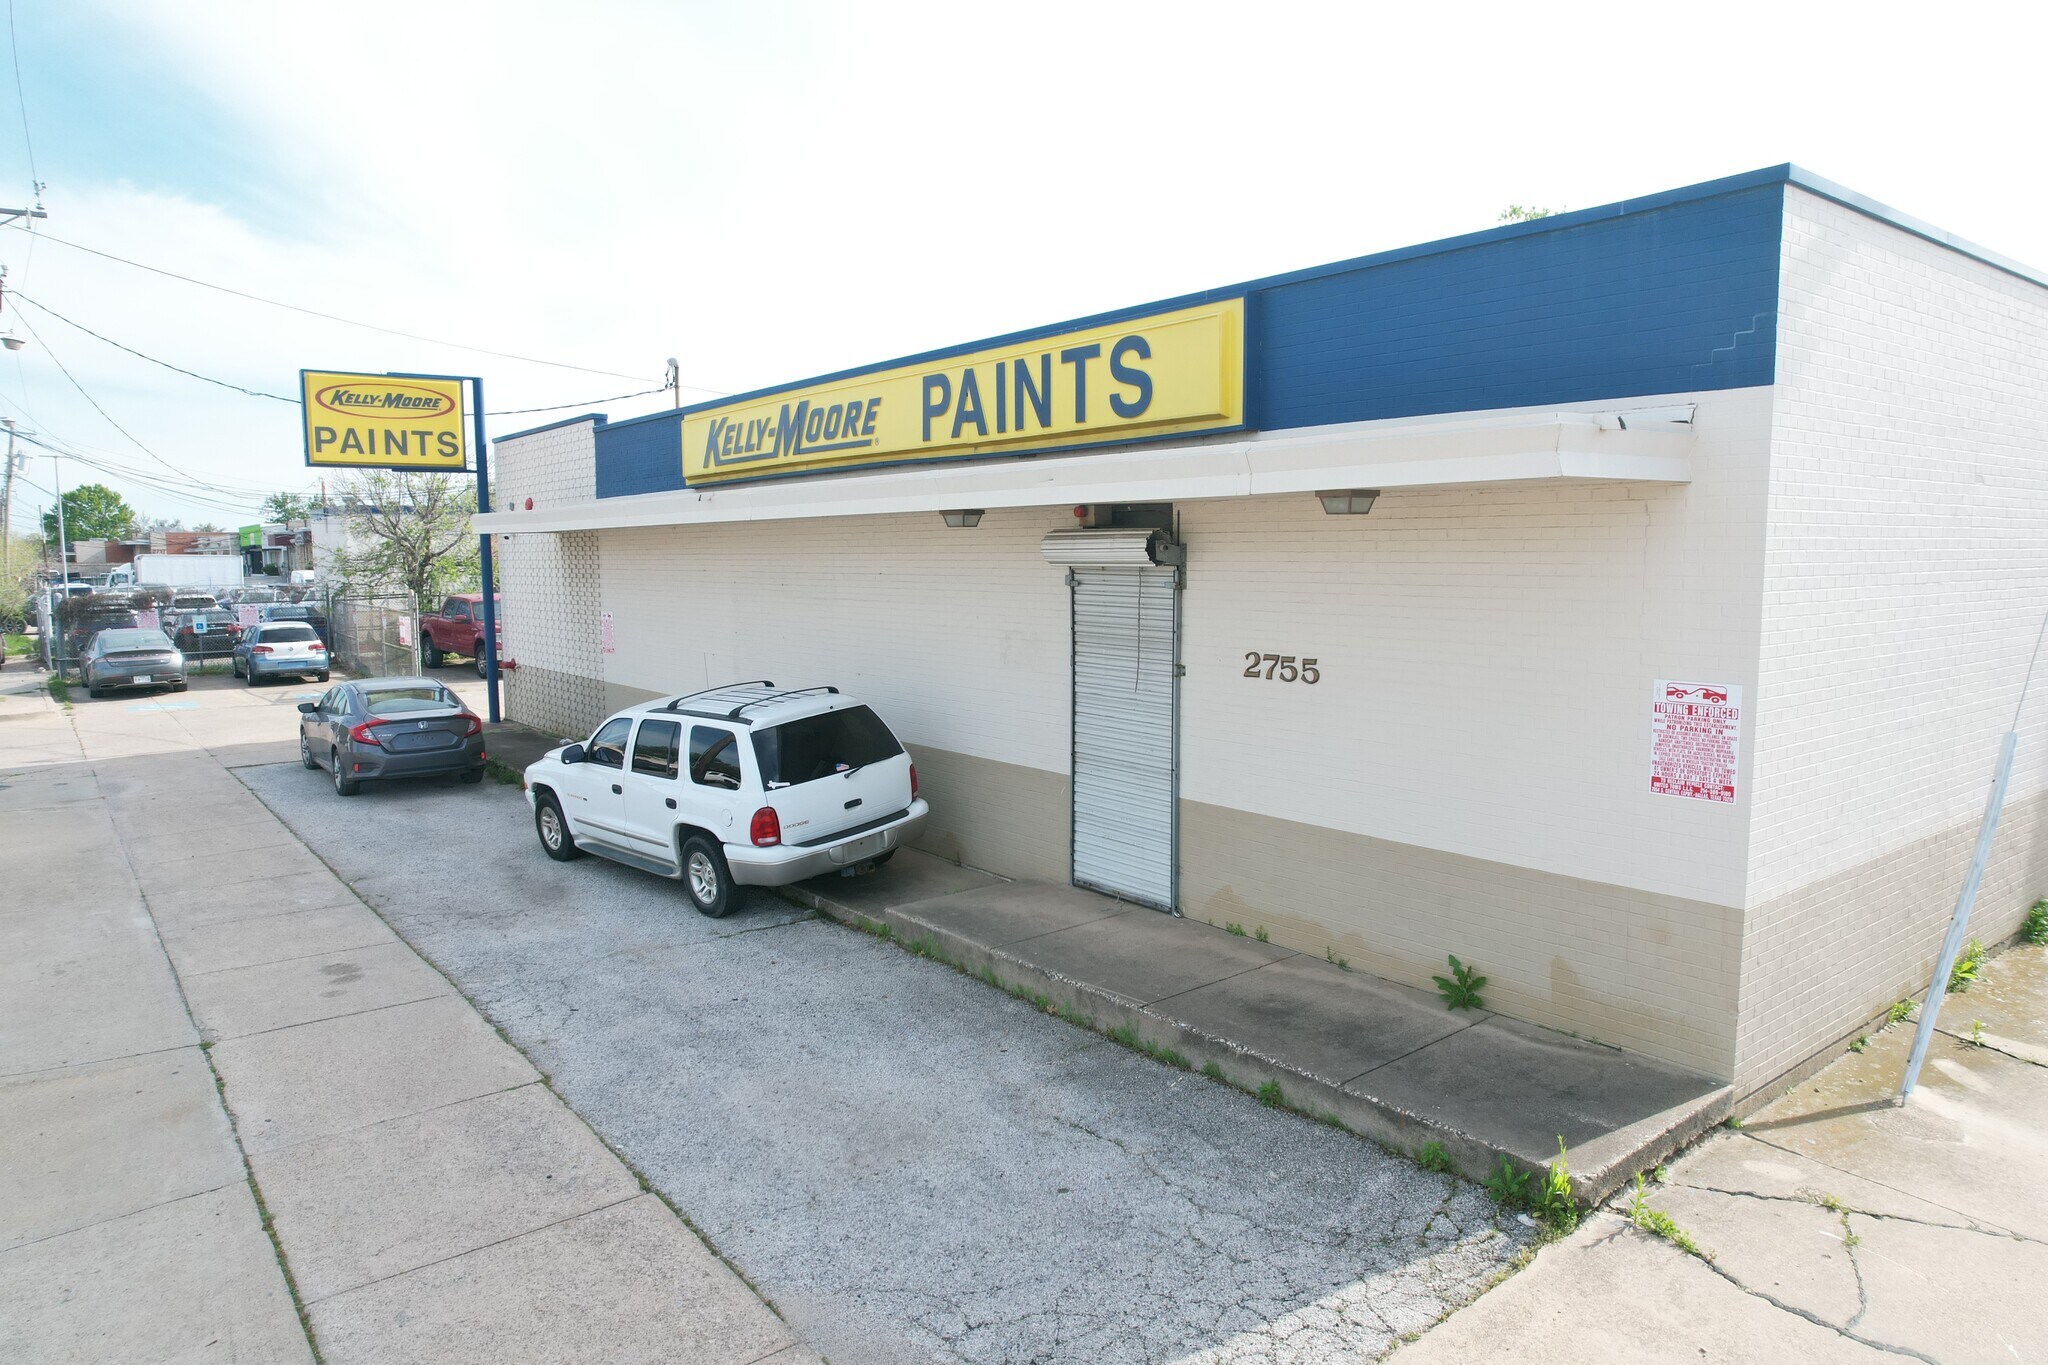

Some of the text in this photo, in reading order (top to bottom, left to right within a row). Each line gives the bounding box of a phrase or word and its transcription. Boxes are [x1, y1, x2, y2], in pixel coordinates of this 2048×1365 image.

[330, 390, 442, 409] KELLY-MOORE
[922, 334, 1153, 441] PAINTS
[315, 426, 459, 457] PAINTS
[703, 397, 881, 468] KELLY-MOORE
[1244, 652, 1320, 684] 2755
[1656, 702, 1738, 718] TOWING ENFORCED
[1679, 725, 1711, 733] PARKING
